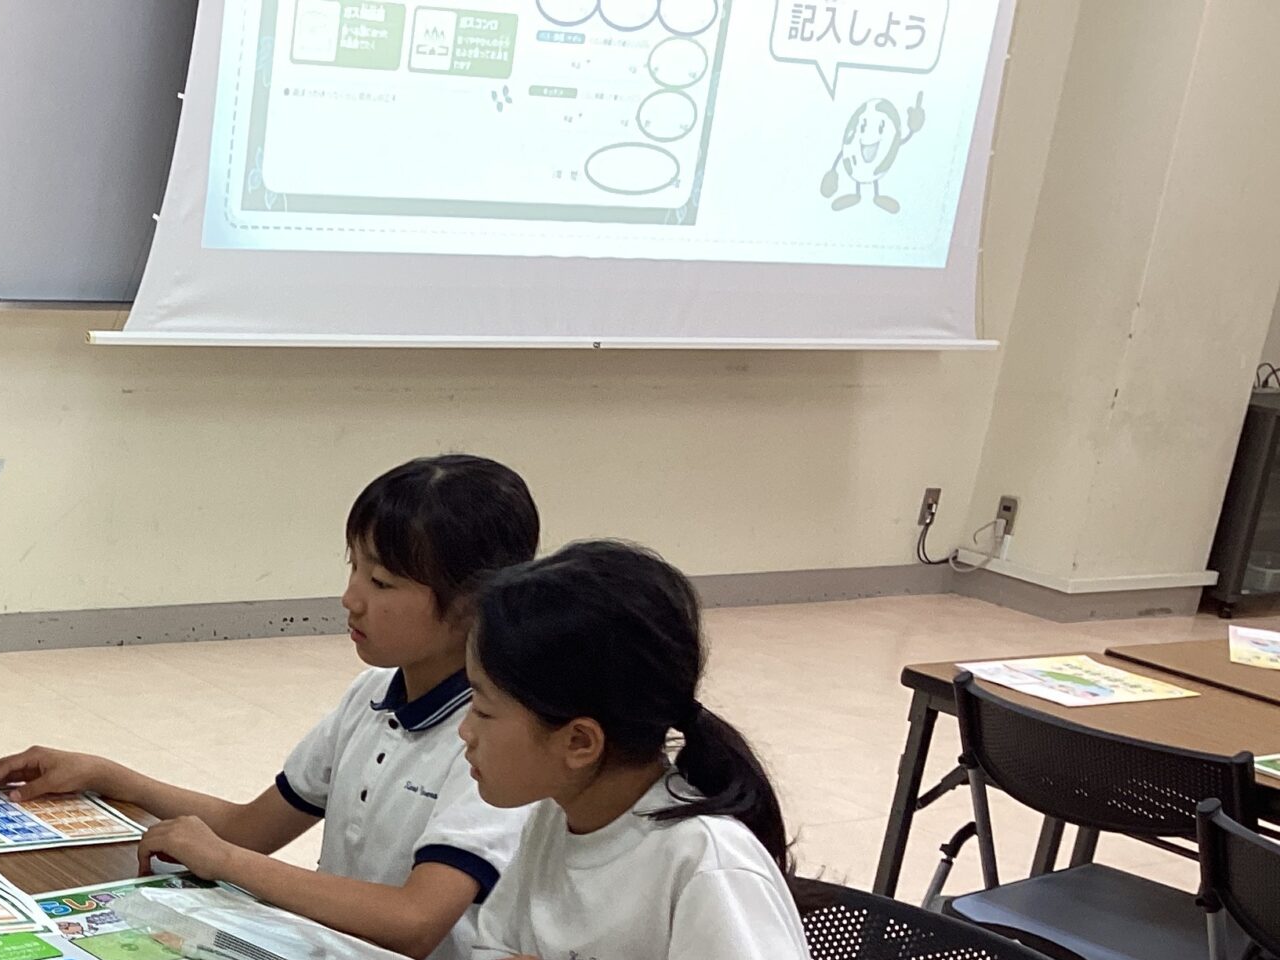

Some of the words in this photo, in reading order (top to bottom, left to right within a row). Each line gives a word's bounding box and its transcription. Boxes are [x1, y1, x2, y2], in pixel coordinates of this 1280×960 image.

[788, 3, 926, 50] 記入しよう
